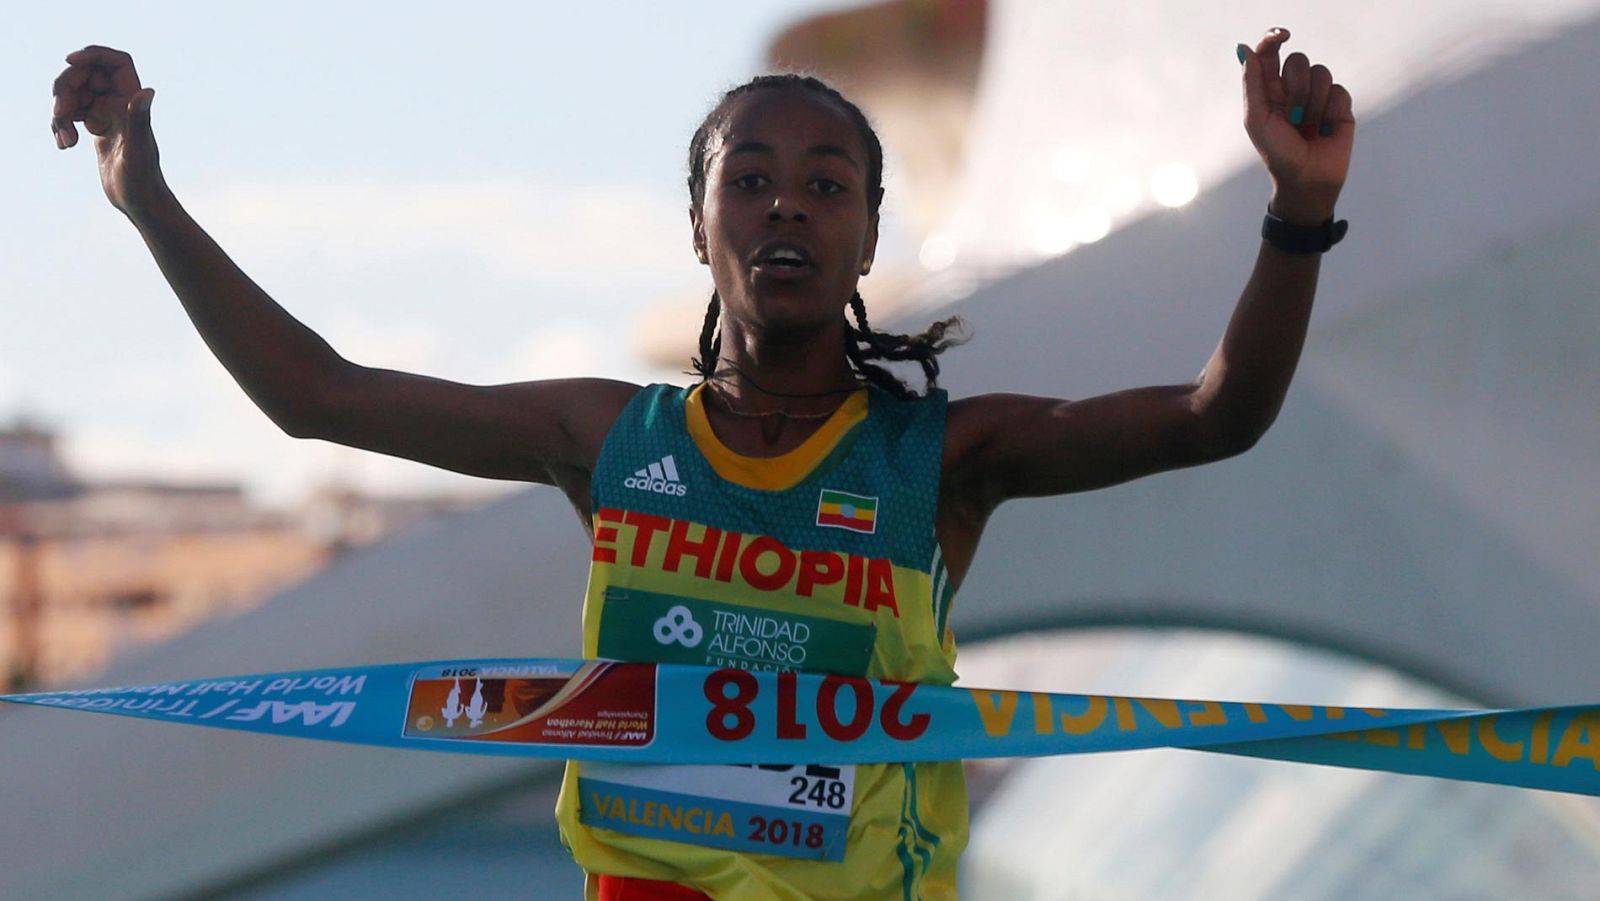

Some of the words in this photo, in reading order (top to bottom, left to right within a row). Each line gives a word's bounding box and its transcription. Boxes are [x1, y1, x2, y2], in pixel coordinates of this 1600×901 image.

[624, 475, 686, 497] adidas
[592, 507, 900, 618] ETHIOPIA
[712, 610, 810, 644] TRINIDAD
[708, 636, 806, 664] ALFONSO
[441, 668, 477, 677] 2018
[186, 679, 262, 696] Half
[265, 675, 367, 695] World
[703, 668, 930, 742] 2018
[547, 718, 594, 729] Marathon
[595, 720, 617, 730] Half
[618, 720, 648, 730] World
[542, 729, 577, 739] Alfonso
[577, 730, 613, 740] Trinidad
[788, 776, 846, 809] 248
[592, 792, 735, 839] VALENCIA
[747, 815, 824, 849] 2018
